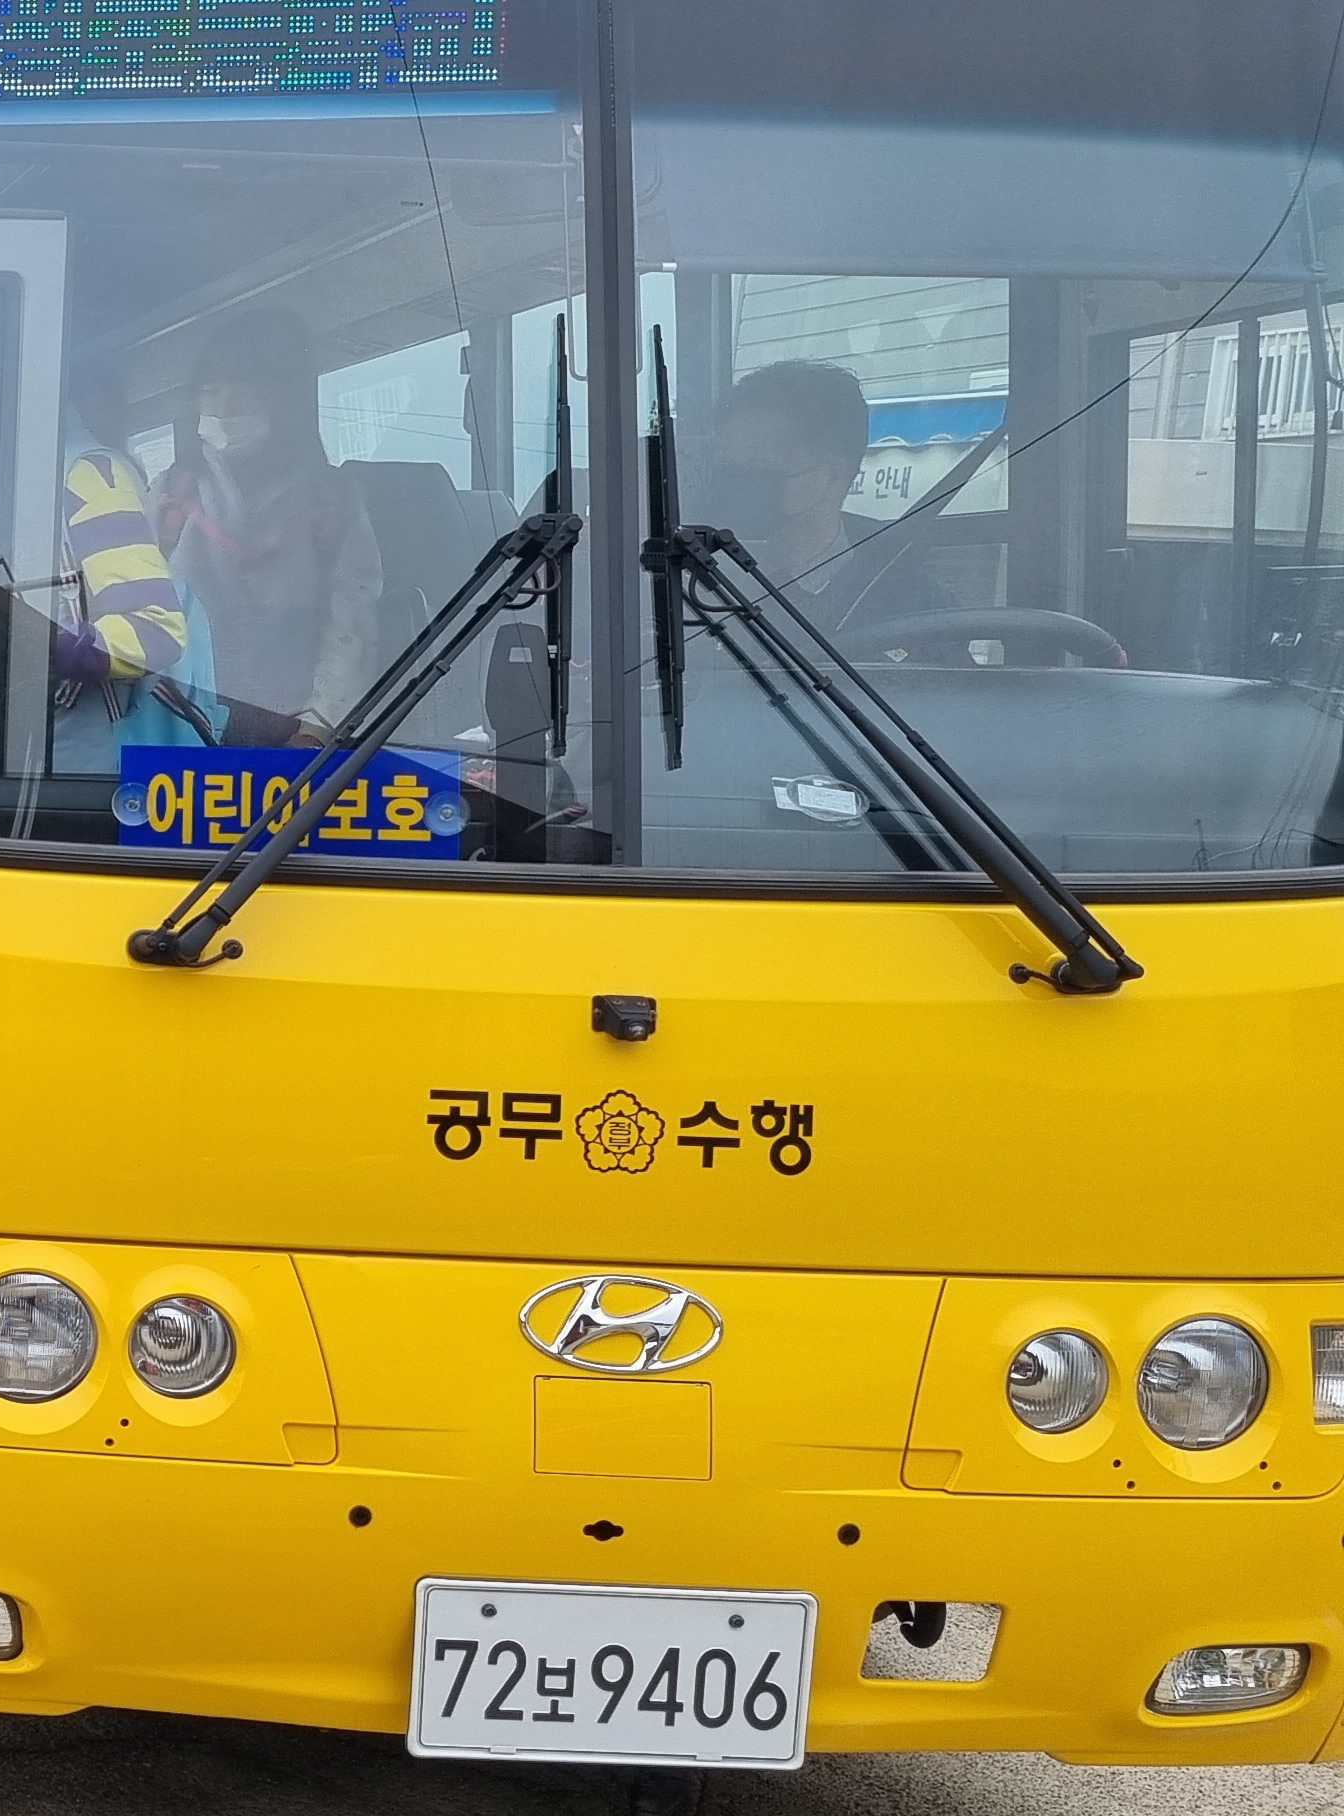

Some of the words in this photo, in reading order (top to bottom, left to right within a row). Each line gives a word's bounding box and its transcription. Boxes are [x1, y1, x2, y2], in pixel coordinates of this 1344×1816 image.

[875, 466, 912, 499] 안내
[426, 1089, 564, 1161] 공무
[676, 1099, 814, 1177] 수행
[433, 1638, 789, 1731] 72보9406
